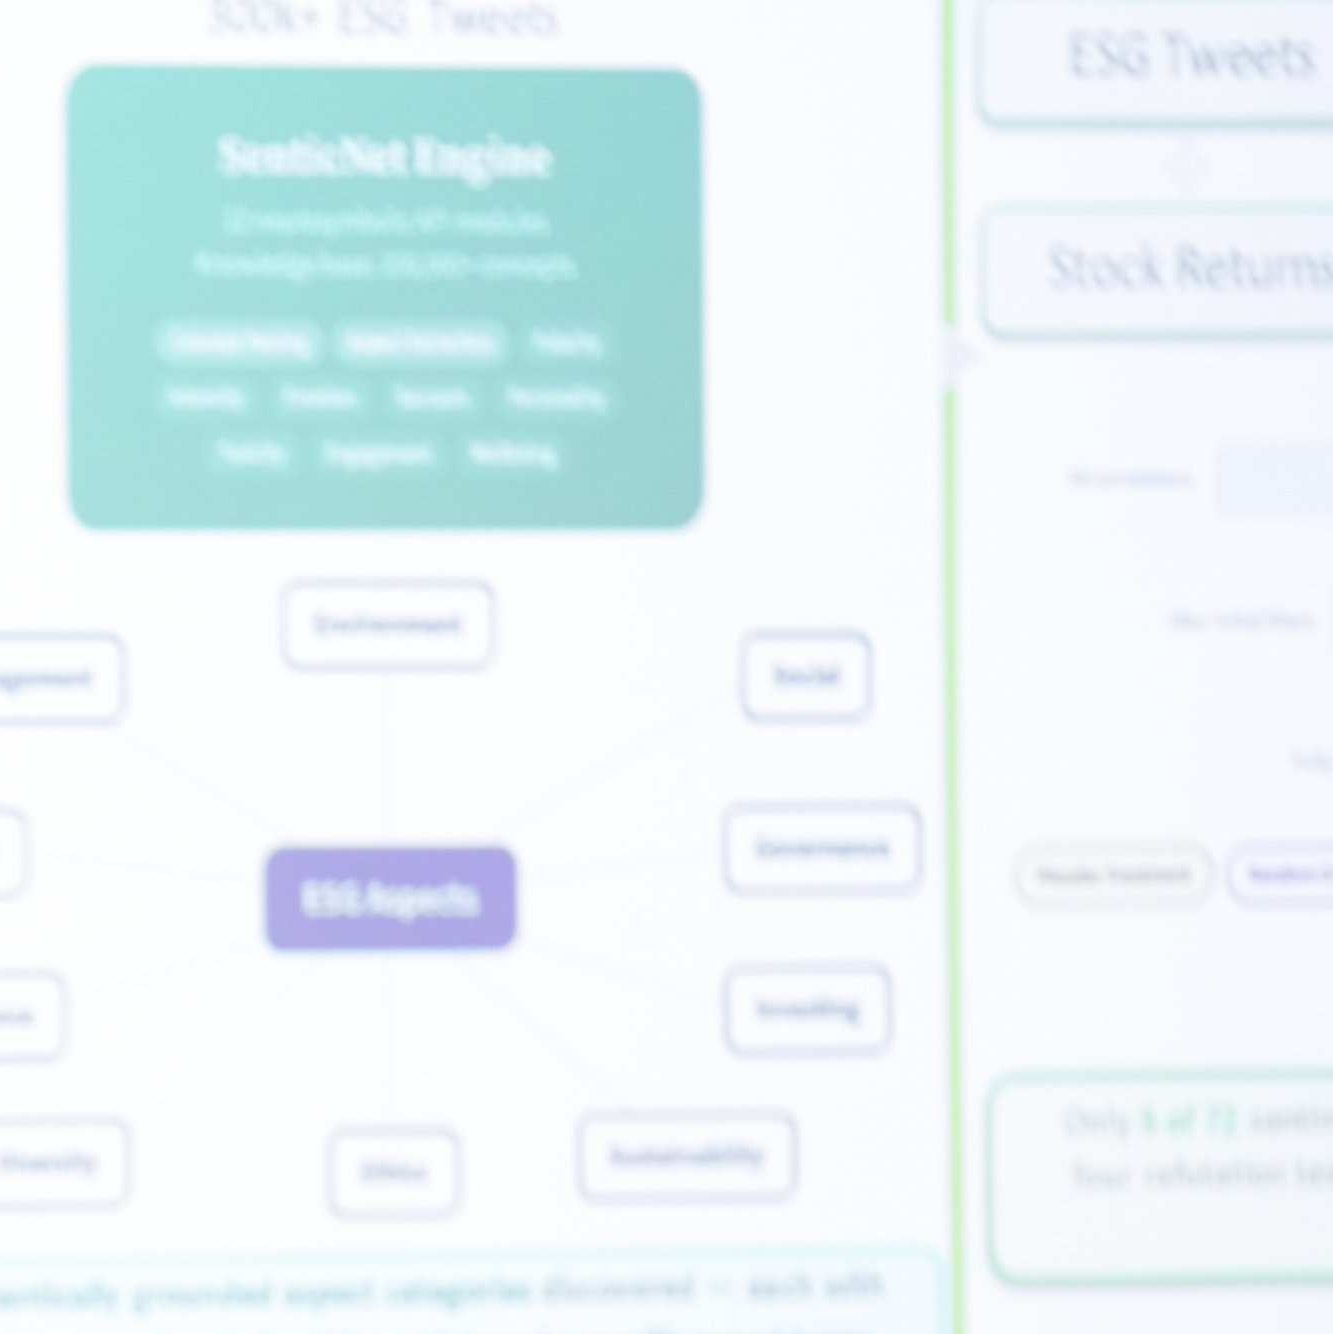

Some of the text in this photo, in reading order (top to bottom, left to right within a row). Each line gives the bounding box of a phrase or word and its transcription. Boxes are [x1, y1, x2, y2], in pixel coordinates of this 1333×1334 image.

[1068, 28, 1320, 80] ESG Tweets
[412, 131, 557, 191] Engine
[1046, 238, 1166, 294] Stock
